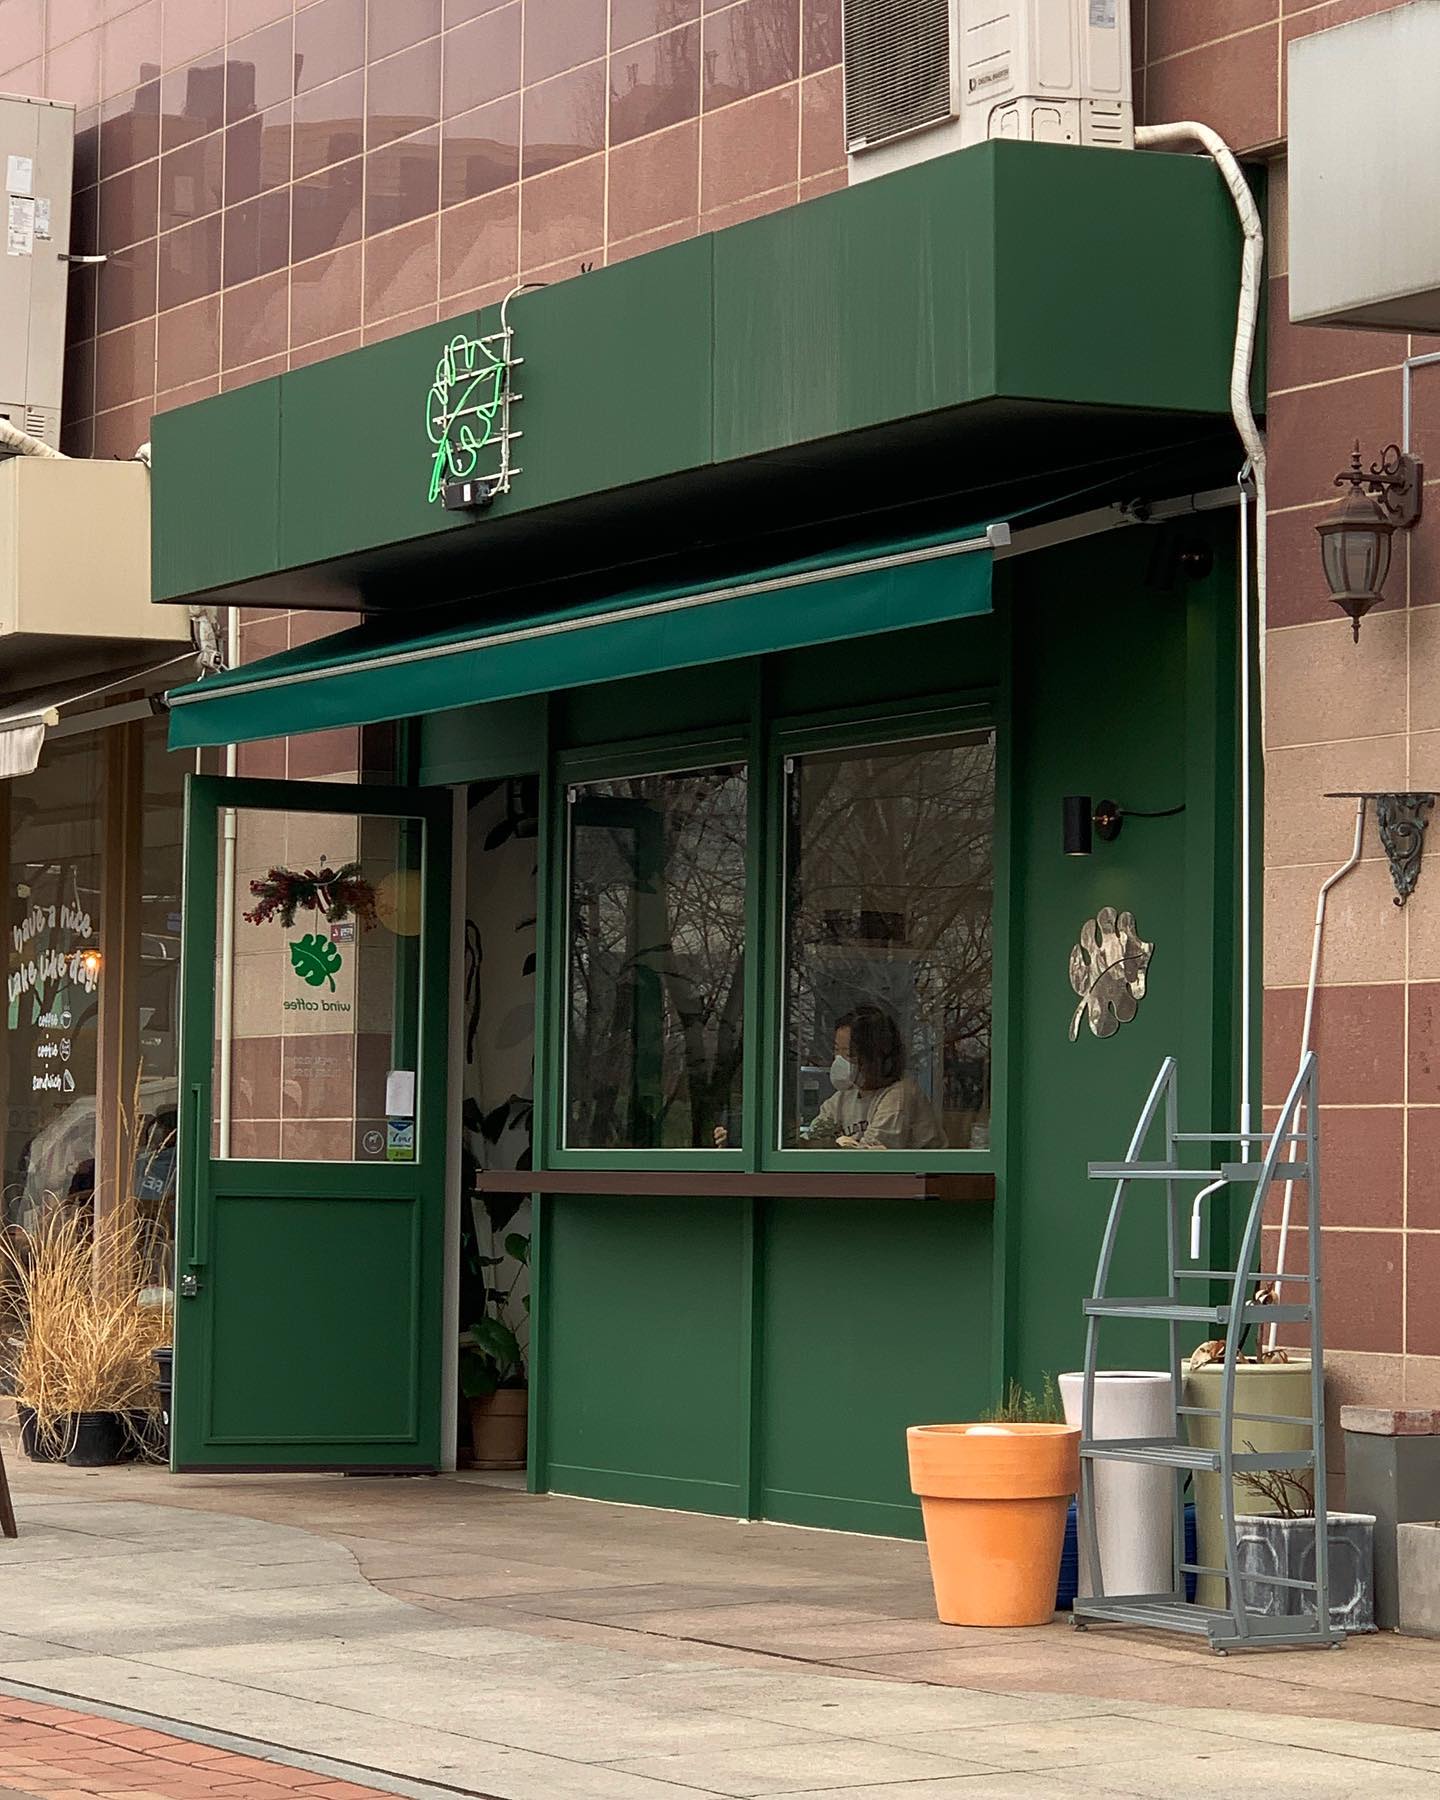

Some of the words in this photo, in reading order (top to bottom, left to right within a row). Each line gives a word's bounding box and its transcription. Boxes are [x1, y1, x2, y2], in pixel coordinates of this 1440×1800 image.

[13, 907, 46, 954] have
[48, 904, 56, 928] a
[60, 901, 92, 938] nice
[38, 1012, 59, 1028] coffee
[37, 1042, 59, 1058] cookie
[32, 1072, 62, 1092] sandwich
